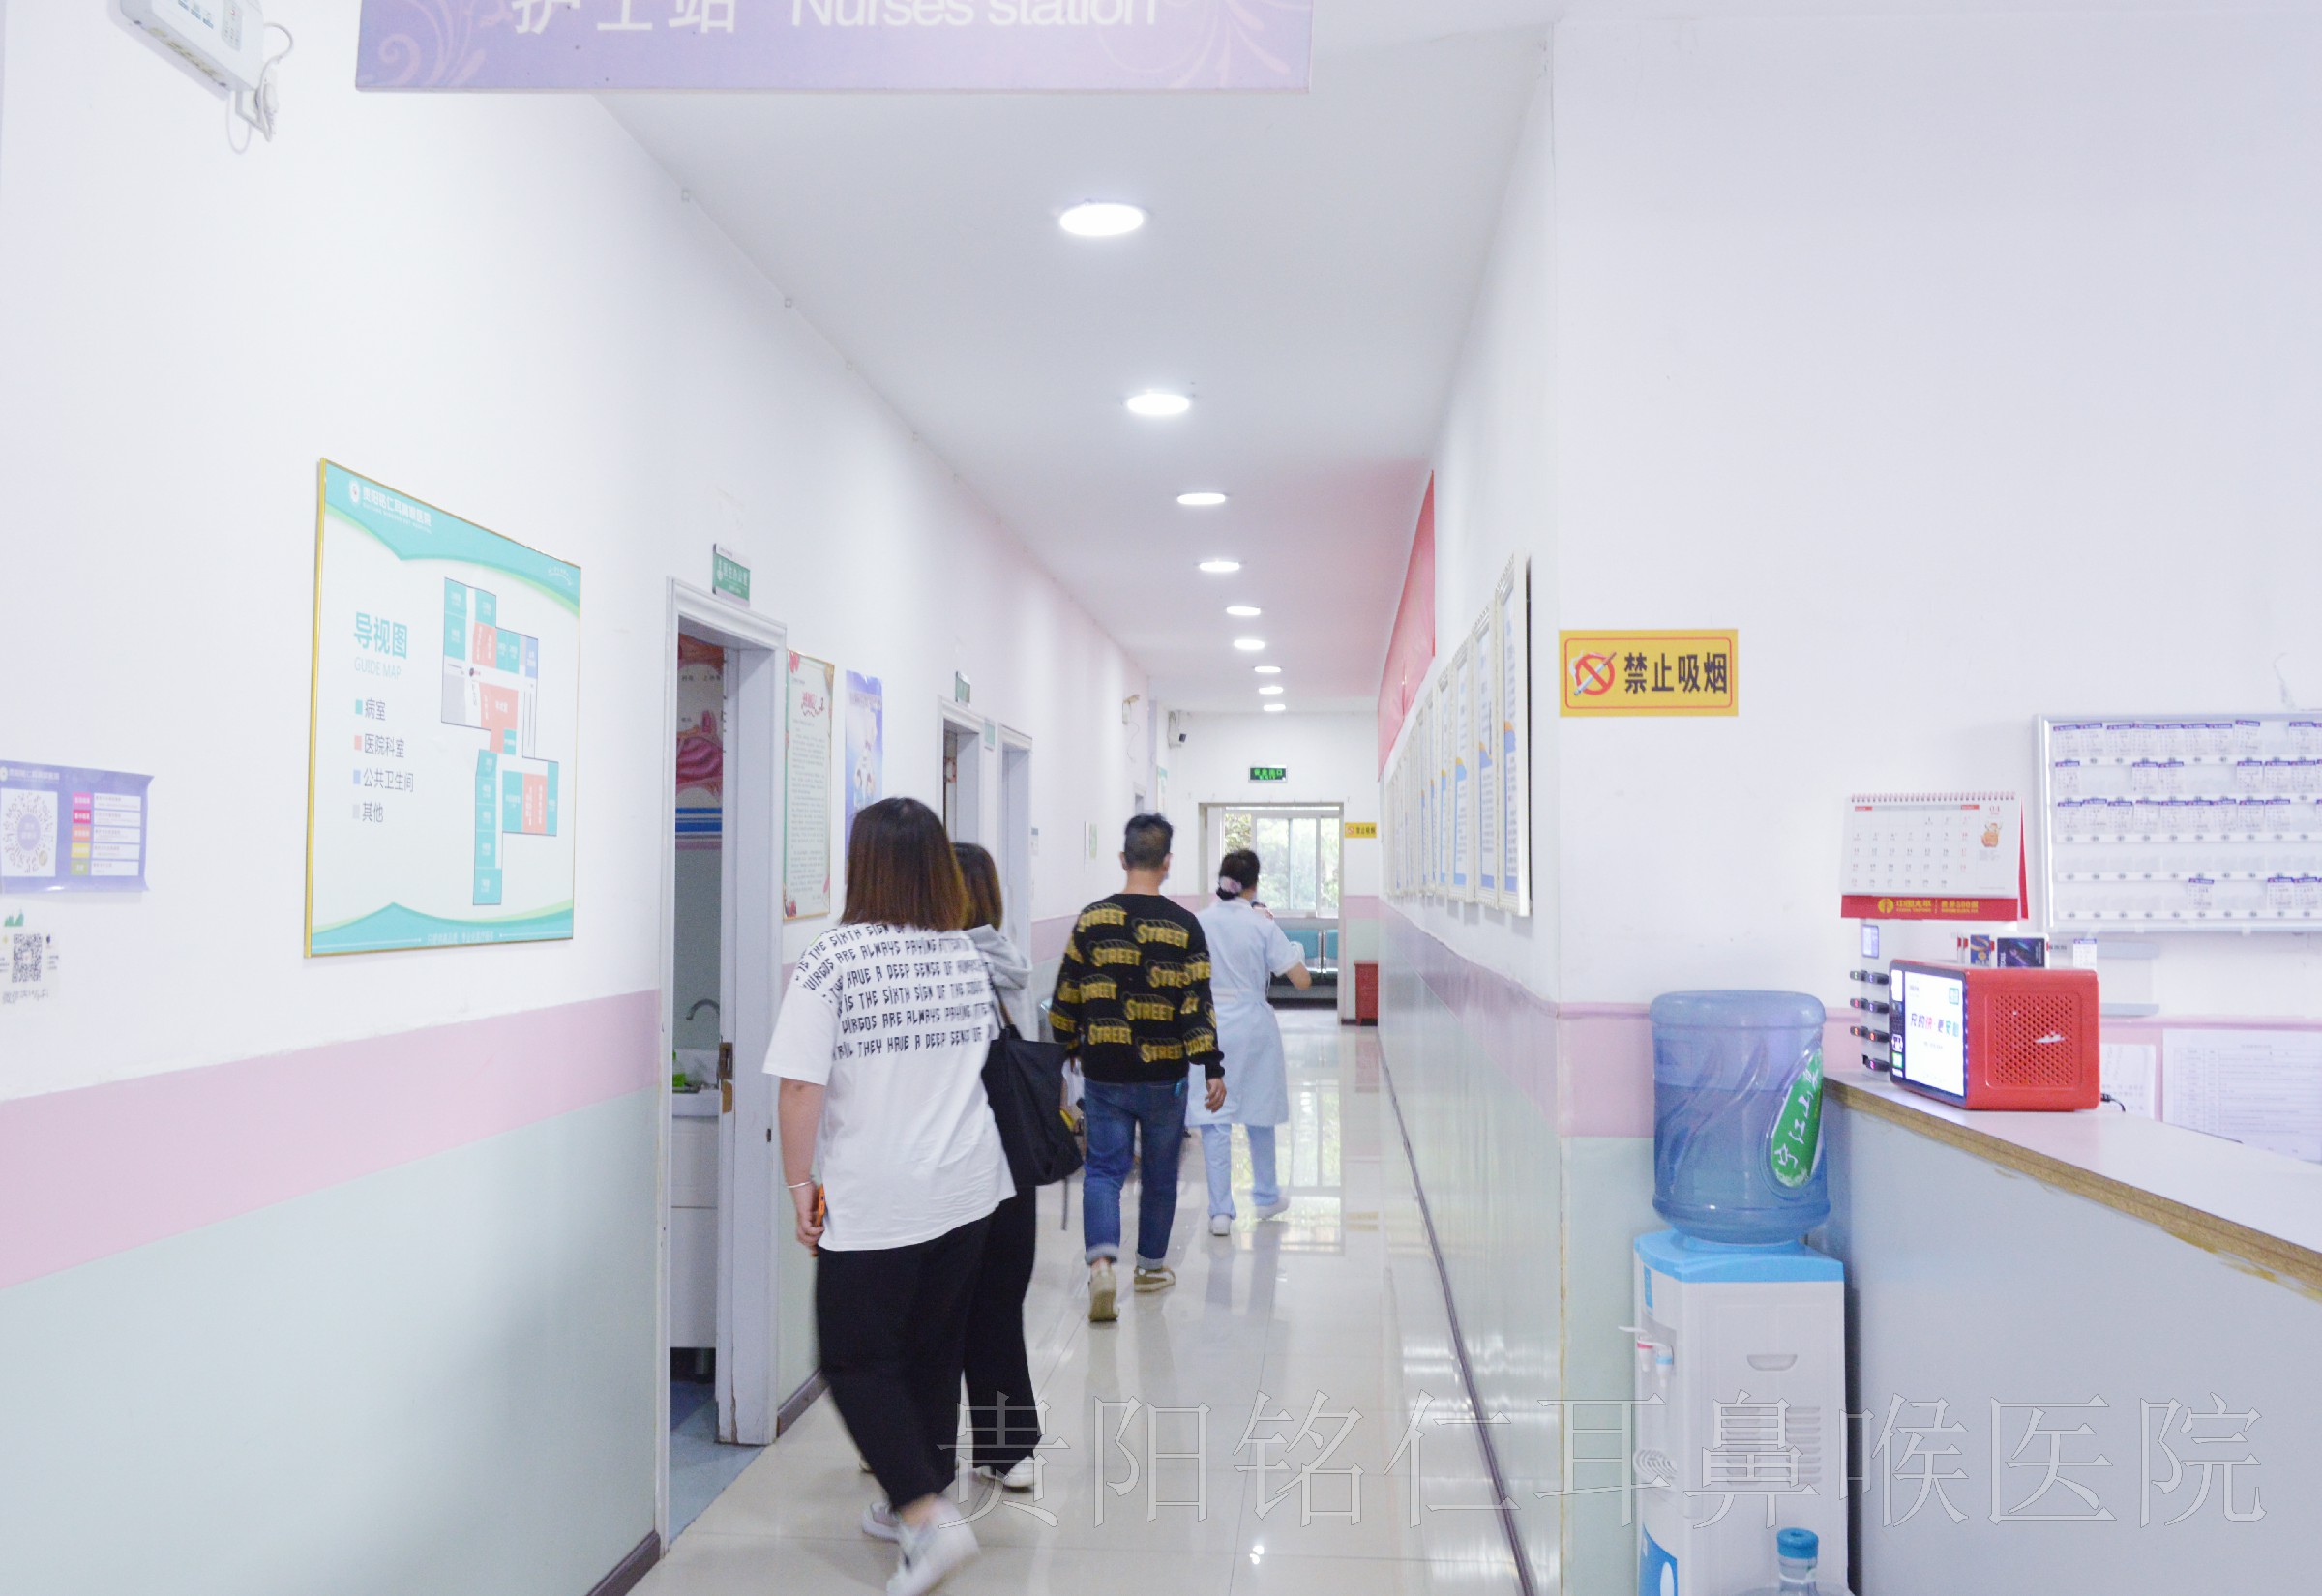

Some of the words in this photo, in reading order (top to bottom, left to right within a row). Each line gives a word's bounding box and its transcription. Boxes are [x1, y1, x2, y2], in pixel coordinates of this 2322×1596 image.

[791, 0, 975, 27] Nurses
[987, 0, 1156, 27] station
[353, 611, 408, 659] 导视图
[354, 656, 381, 676] GUIDE
[383, 664, 402, 681] MAP
[1624, 651, 1728, 694] 禁止吸烟
[364, 697, 386, 721] 病室
[364, 733, 405, 758] 医院科室
[363, 767, 414, 793] 公共卫生间
[362, 802, 384, 823] 其他
[1137, 923, 1189, 950] STREET
[809, 941, 826, 960] THE
[835, 948, 856, 964] ARE
[860, 941, 901, 960] ALWAYS
[1091, 946, 1142, 968] STREET
[887, 963, 909, 979] DEEP
[913, 961, 941, 978] SENSE
[858, 990, 878, 1010] THE
[1125, 998, 1175, 1021] STREET
[881, 1012, 903, 1028] ARE
[906, 1007, 940, 1026] ALWAYS
[857, 1039, 882, 1058] THEY
[925, 1032, 946, 1049] DEEP
[1088, 1023, 1133, 1046] STREET
